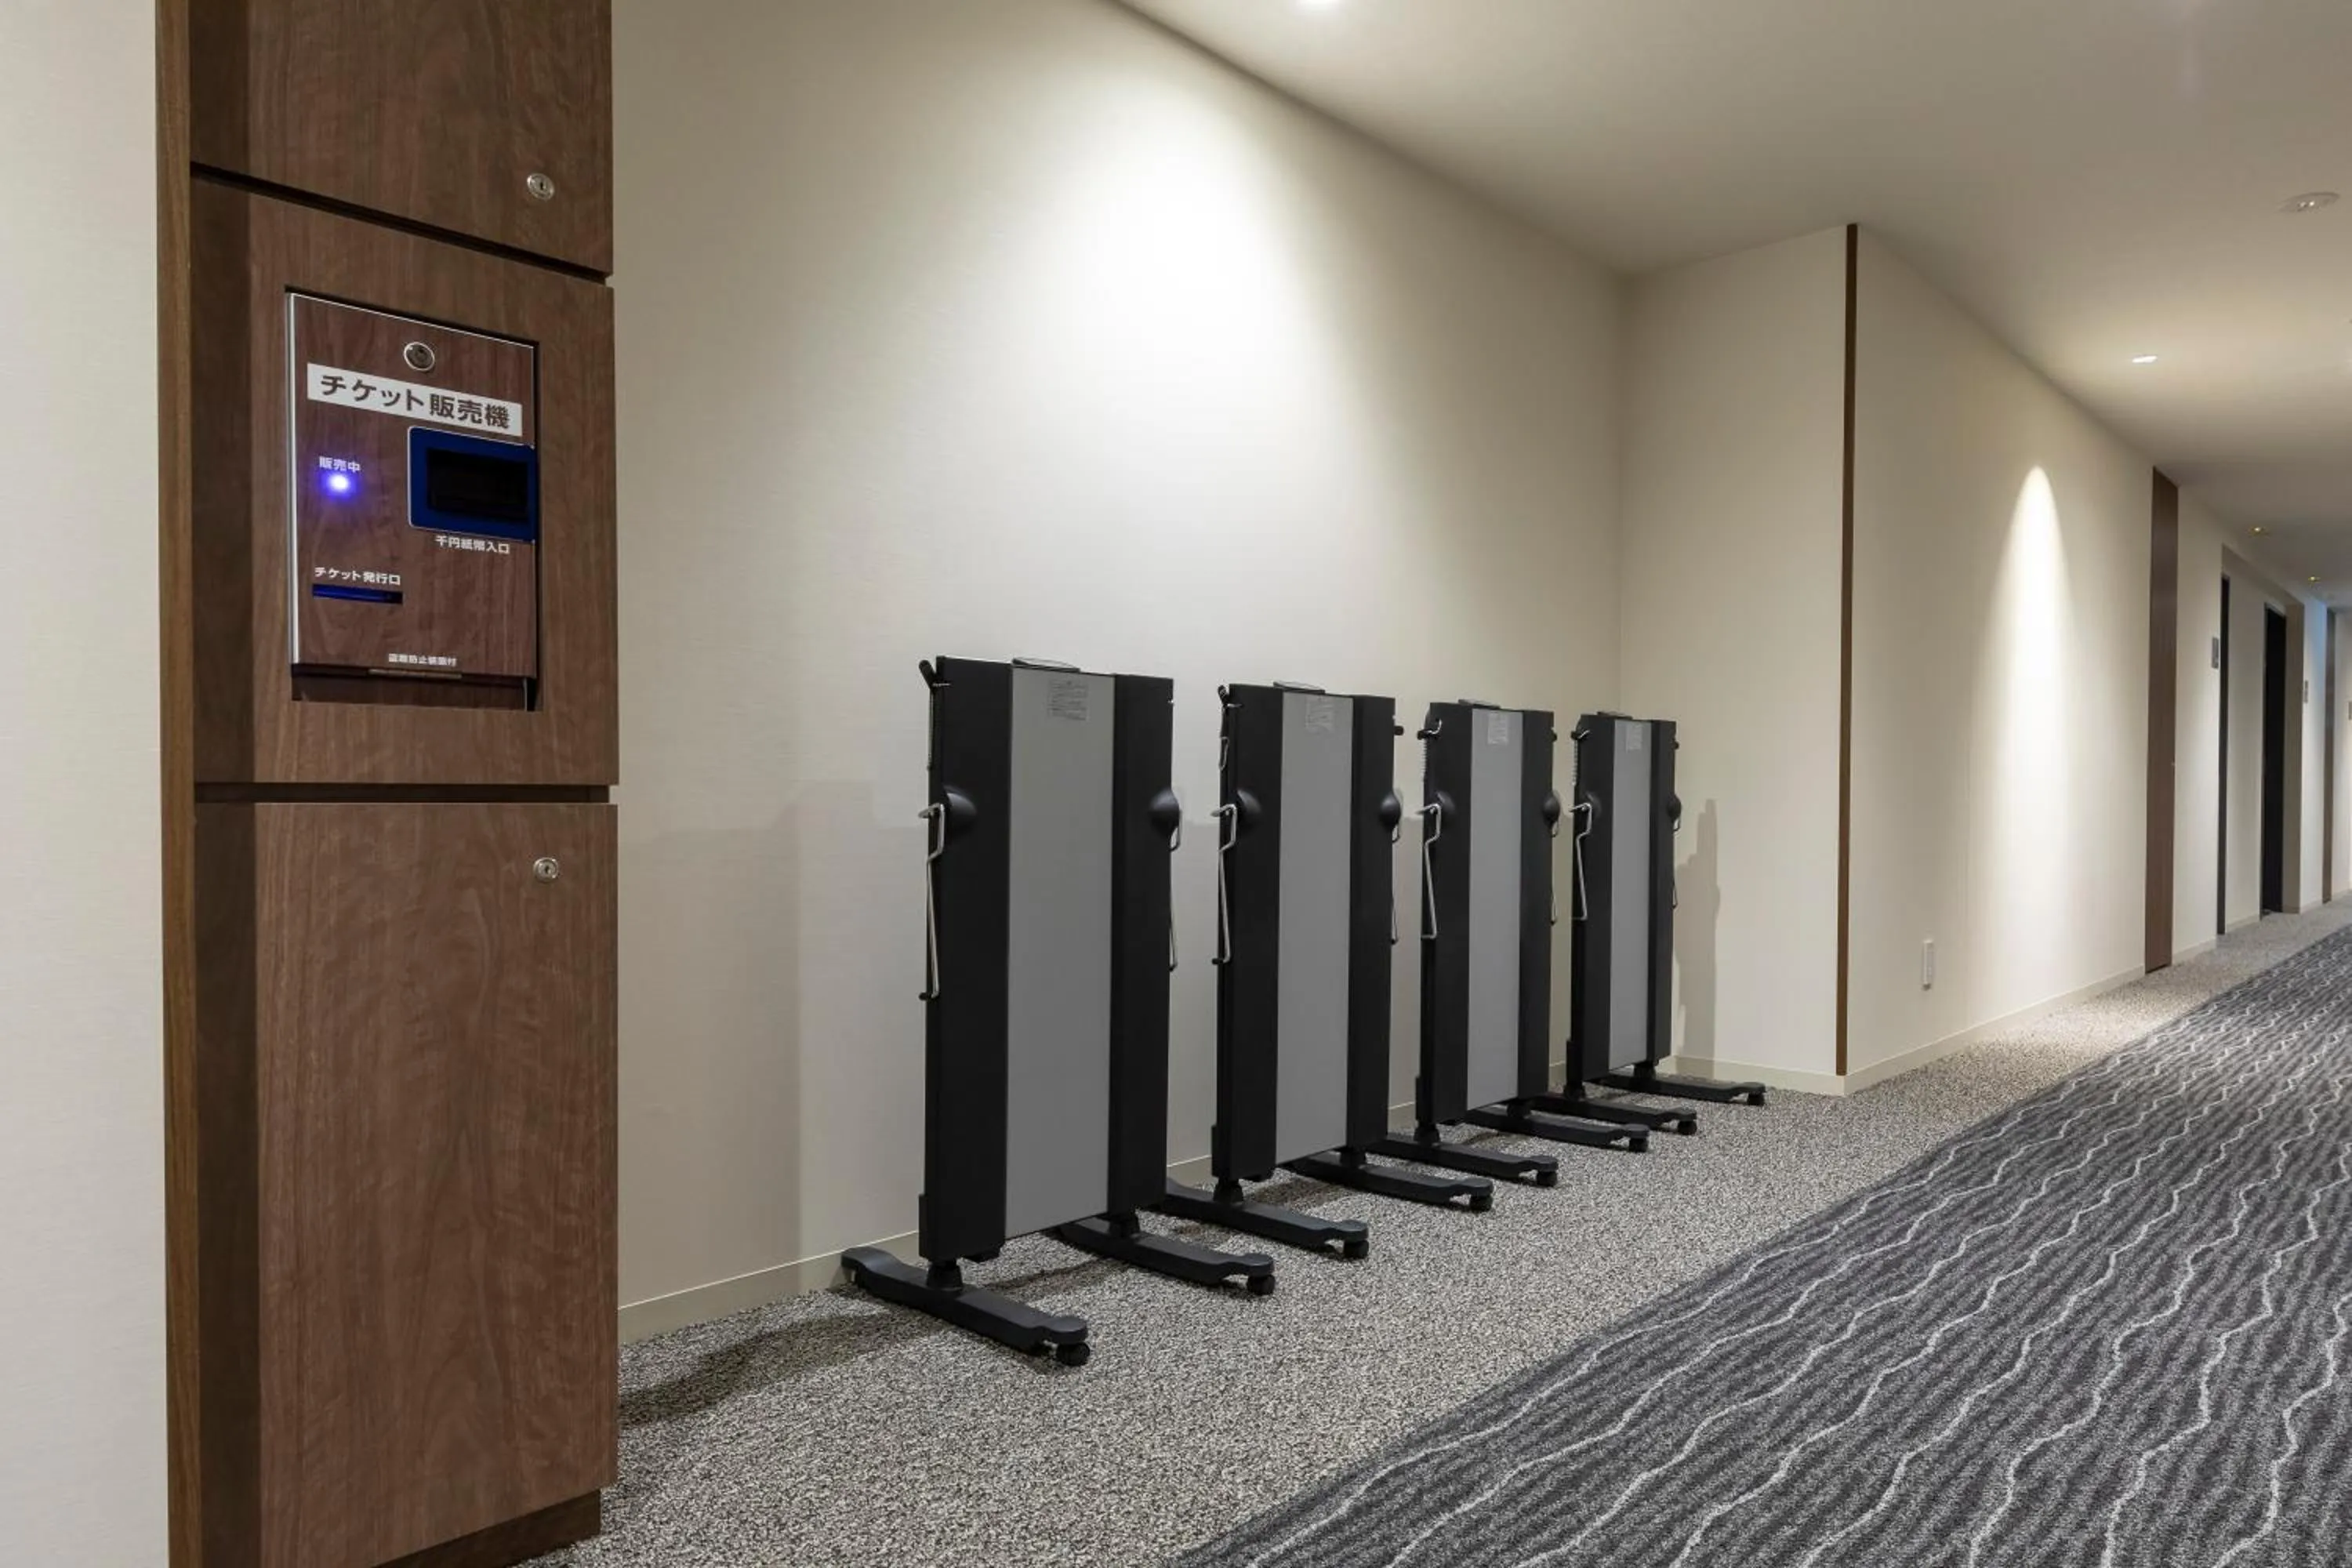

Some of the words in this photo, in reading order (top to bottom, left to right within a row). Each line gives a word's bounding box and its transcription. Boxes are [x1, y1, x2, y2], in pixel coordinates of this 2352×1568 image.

[321, 375, 510, 429] チケット販売機
[314, 567, 401, 585] チケット発行口
